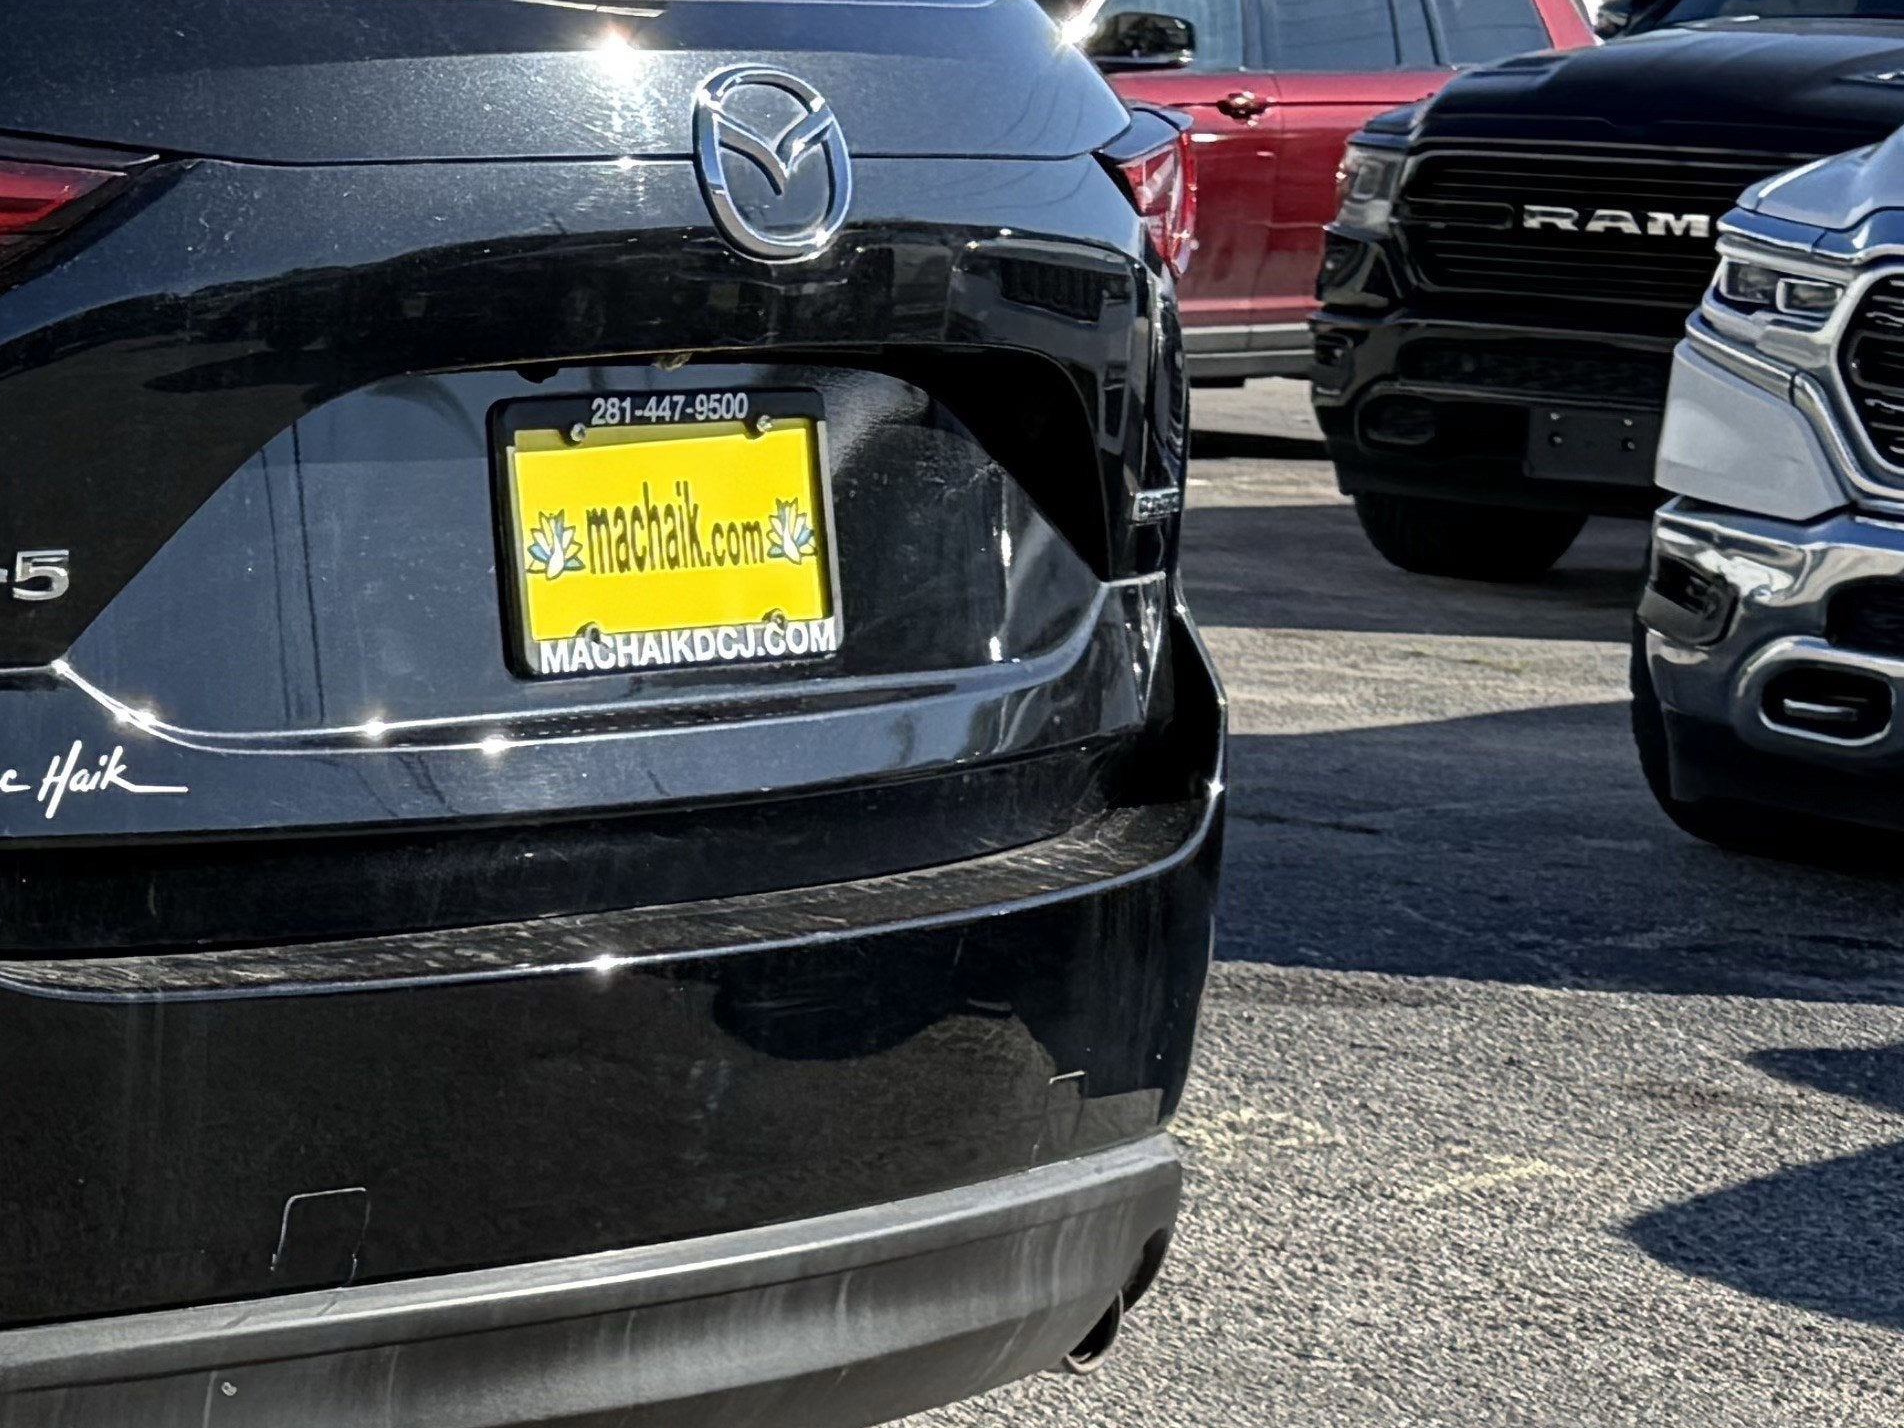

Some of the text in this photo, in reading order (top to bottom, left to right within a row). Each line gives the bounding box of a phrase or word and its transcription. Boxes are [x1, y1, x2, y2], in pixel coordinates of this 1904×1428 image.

[1523, 204, 1710, 238] RAM
[592, 392, 748, 426] 281-447-9500
[586, 480, 765, 575] machaik.com
[539, 617, 838, 675] MACHAIKDCJ.COM
[37, 740, 189, 819] Haik
